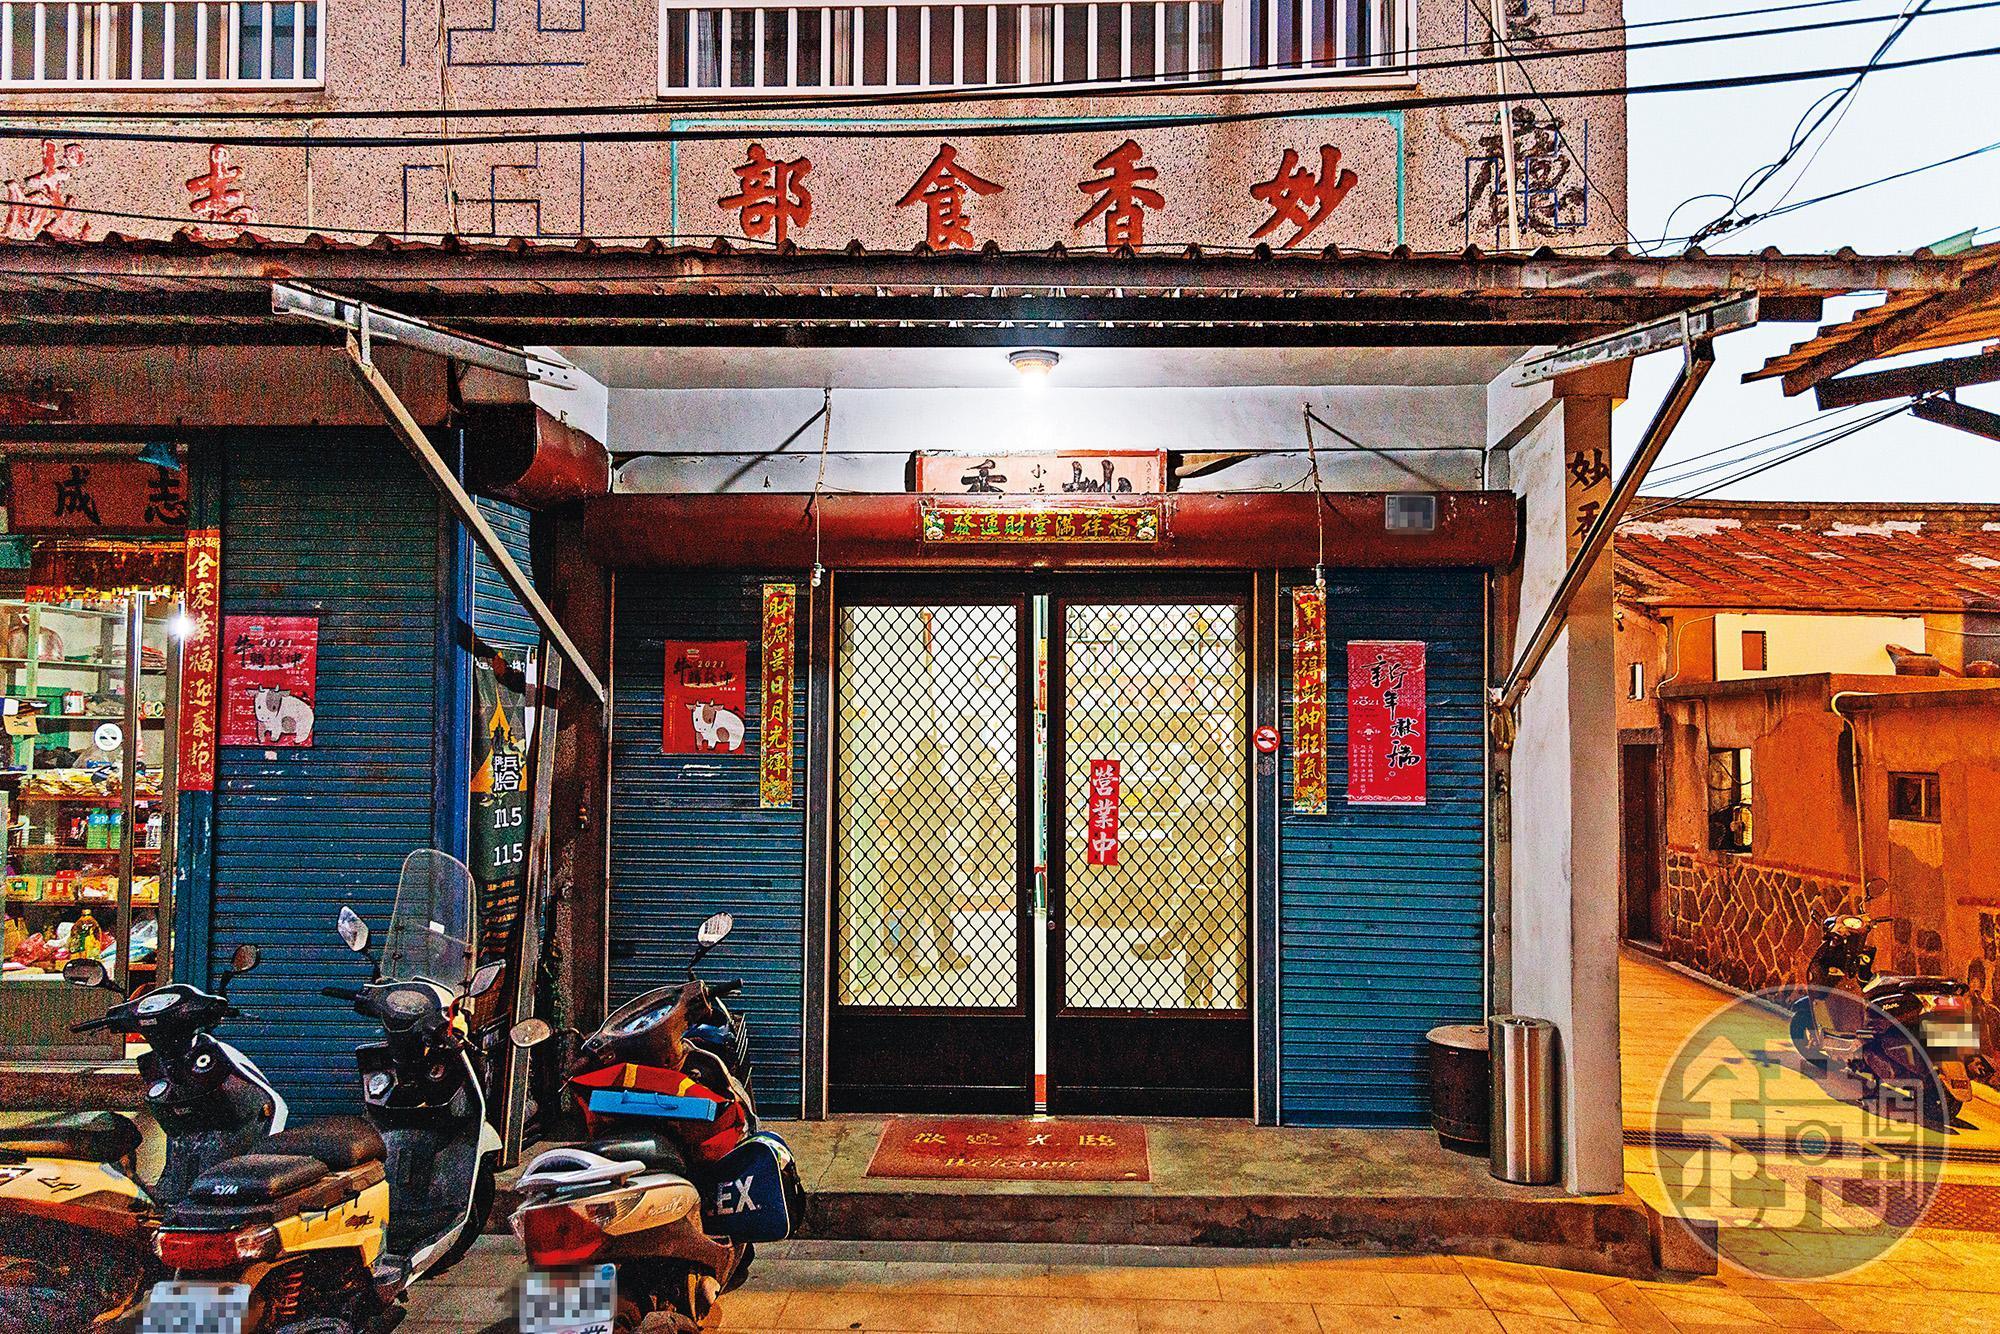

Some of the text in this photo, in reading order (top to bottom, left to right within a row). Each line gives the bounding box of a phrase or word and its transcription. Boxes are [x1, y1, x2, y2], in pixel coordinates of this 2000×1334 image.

[717, 138, 1359, 252] 妙香食部
[53, 464, 190, 528] 志成
[262, 638, 292, 648] 2021
[697, 661, 725, 669] 2021
[766, 596, 790, 776] 財源呈日月光輝
[1298, 600, 1322, 780] 事業得乾坤旺氣
[1362, 655, 1421, 769] 新年獻瑞
[493, 806, 523, 829] 115
[1091, 764, 1118, 863] 營業中
[493, 842, 523, 867] 115
[911, 1131, 1118, 1148] 歡迎光臨
[211, 1185, 239, 1196] SYM
